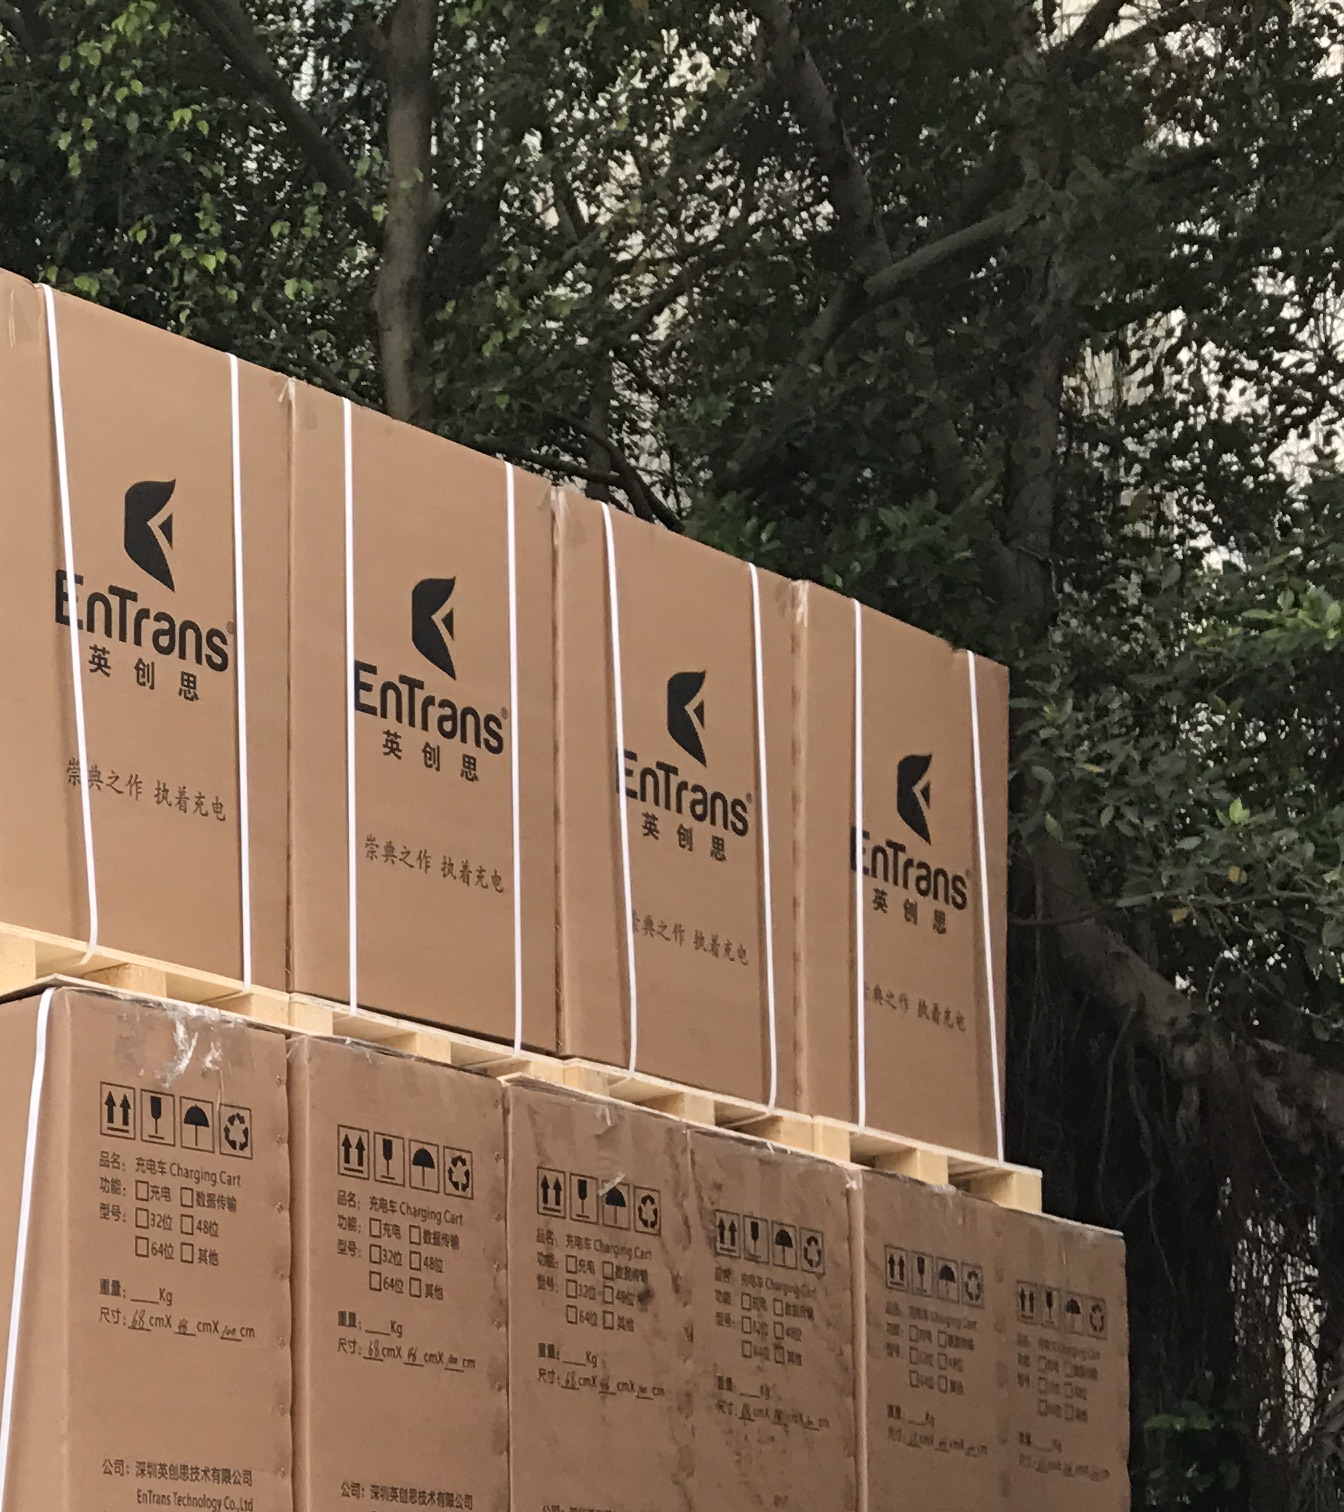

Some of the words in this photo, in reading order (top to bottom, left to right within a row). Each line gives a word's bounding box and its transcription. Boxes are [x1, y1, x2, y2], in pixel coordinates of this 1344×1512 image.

[55, 569, 229, 672] EnTrans
[88, 644, 200, 702] 英创思
[353, 659, 504, 755] EnTrans
[383, 730, 479, 782] 英创思
[154, 780, 226, 822] 执着充电
[616, 748, 748, 837] EnTrans
[642, 812, 726, 862] 英创思
[365, 834, 431, 873] 崇典之作
[441, 855, 504, 893] 执着充电
[851, 826, 967, 910] EnTrans
[135, 1157, 167, 1176] 充电车
[170, 1163, 217, 1186] Charging
[220, 1171, 241, 1187] Cart
[150, 1213, 172, 1230] 32位
[196, 1219, 219, 1237] 48位
[400, 1202, 441, 1225] Charging
[443, 1209, 463, 1225] Cart
[151, 1242, 174, 1260] 64位
[159, 1287, 172, 1306] Kg
[390, 1320, 402, 1338] Kg
[135, 1461, 252, 1487] 深圳英创思技术有限公司
[137, 1489, 171, 1506] EnTrans
[173, 1492, 221, 1512] Technology
